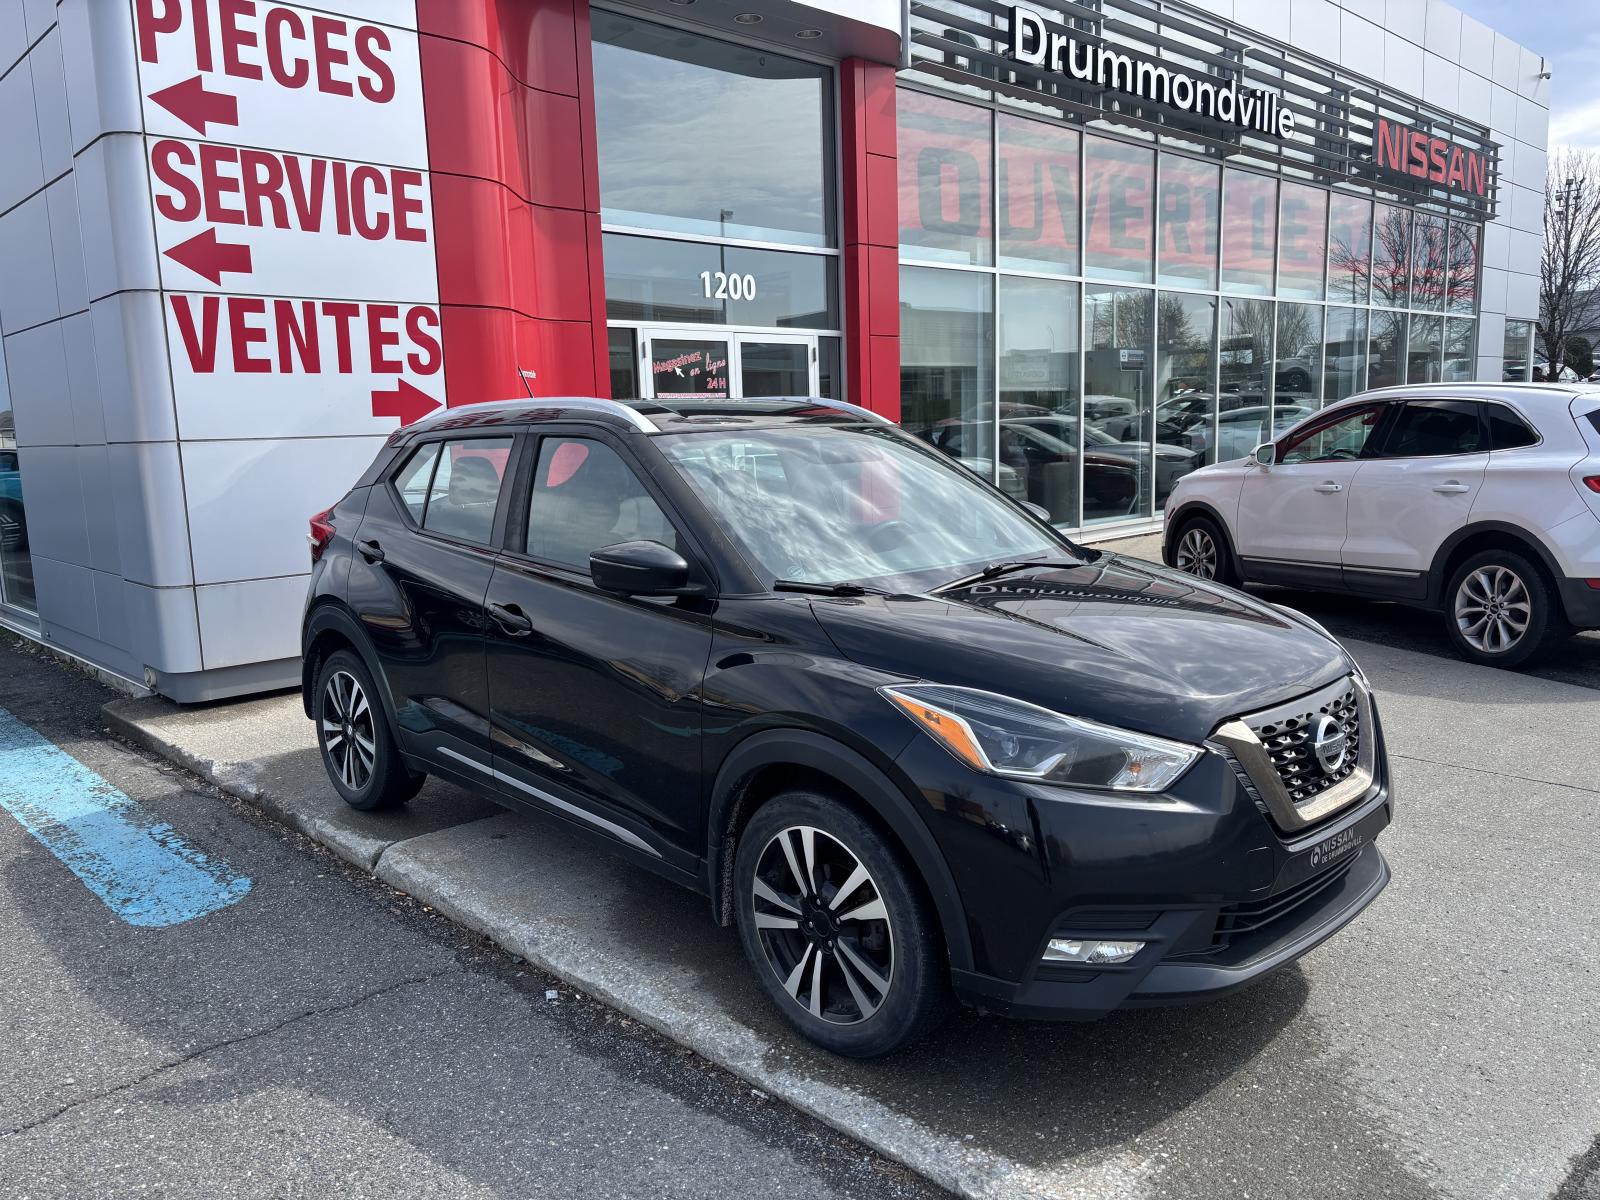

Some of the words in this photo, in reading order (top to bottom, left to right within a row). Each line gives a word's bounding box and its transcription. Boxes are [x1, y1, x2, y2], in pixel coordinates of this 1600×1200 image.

[136, 0, 396, 104] PIECES
[1013, 6, 1296, 139] Drummondville
[151, 139, 428, 243] SERVICE
[917, 146, 1229, 256] OUVERT
[1377, 119, 1485, 196] NISSAN
[700, 270, 756, 301] 1200
[169, 294, 443, 376] VENTES
[1321, 826, 1354, 855] NISSAN
